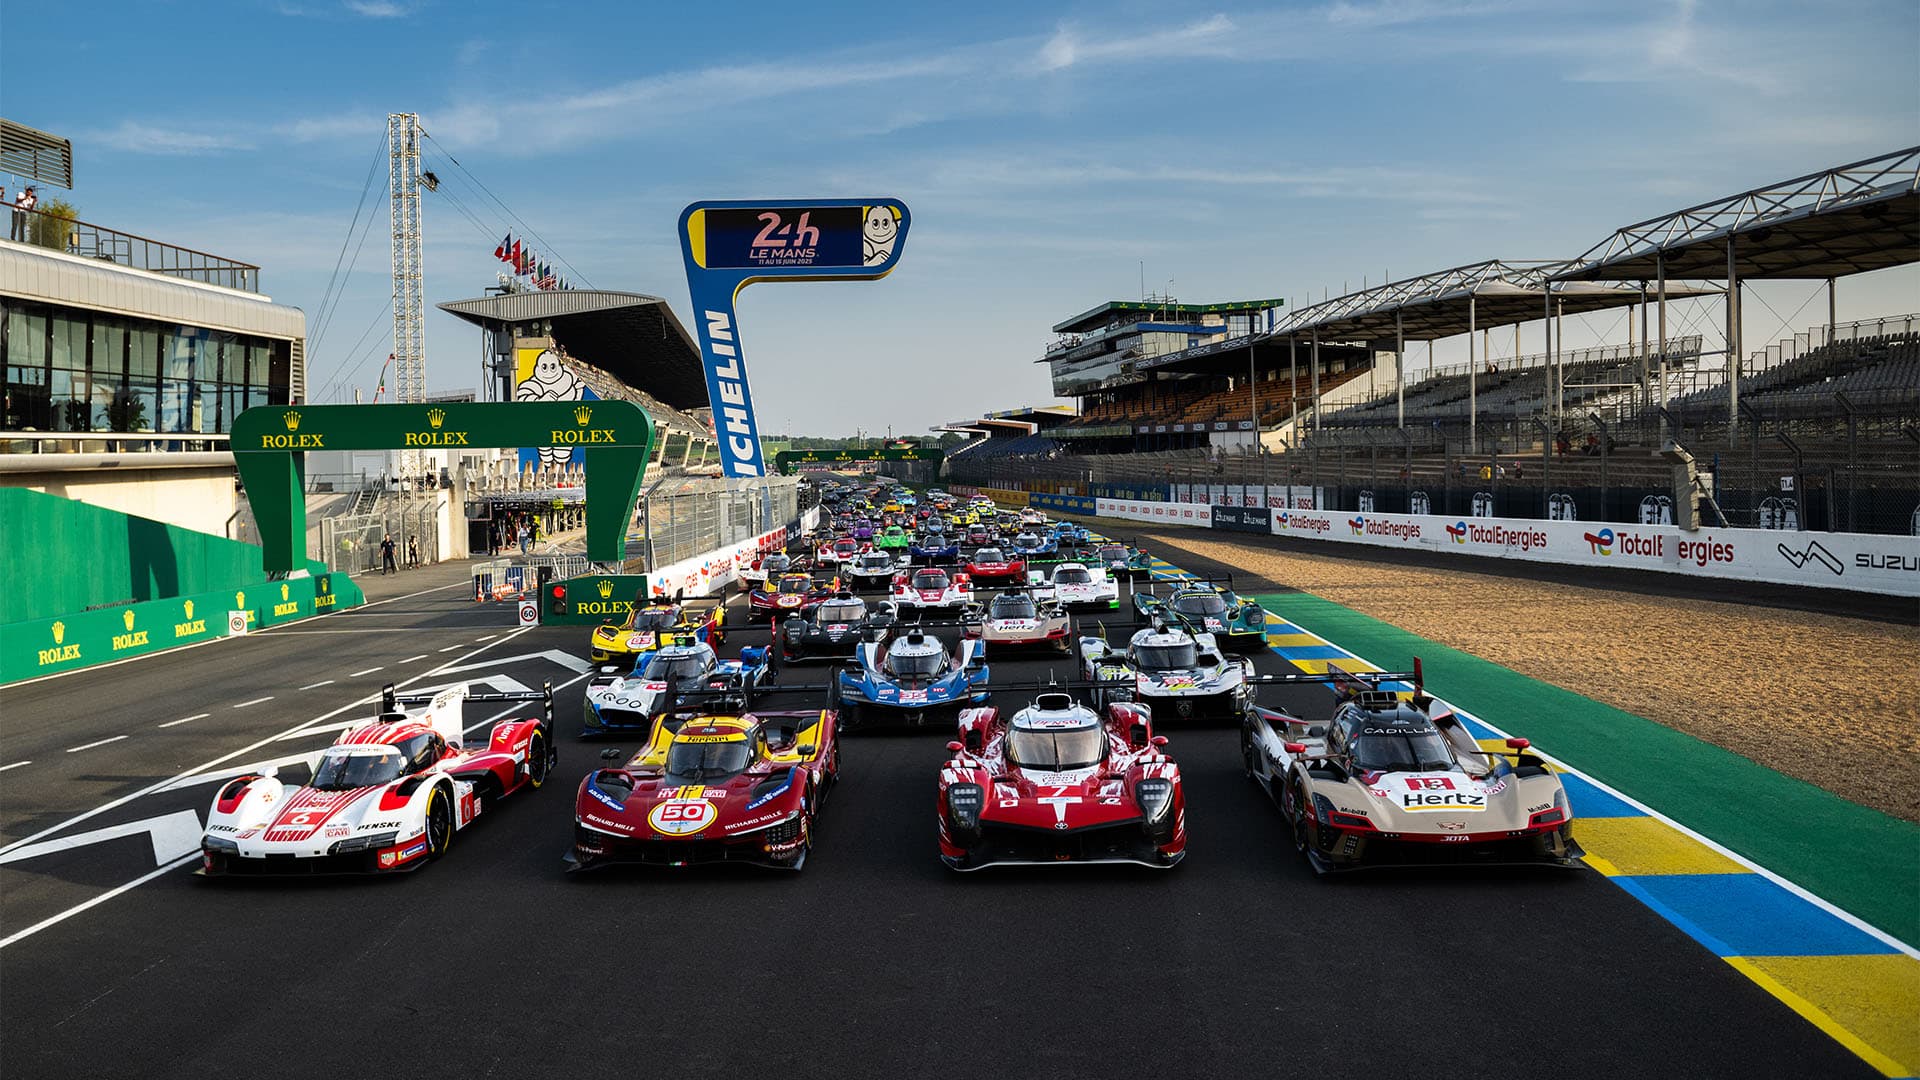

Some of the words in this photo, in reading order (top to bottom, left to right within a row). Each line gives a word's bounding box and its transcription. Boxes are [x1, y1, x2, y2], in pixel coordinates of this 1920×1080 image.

[752, 211, 820, 247] 24h
[750, 249, 768, 258] LE
[771, 248, 816, 258] MANS
[1220, 337, 1248, 349] PORSCHE
[704, 310, 758, 476] ICHELIN
[262, 434, 324, 448] ROLEX
[405, 432, 468, 445] ROLEX
[551, 429, 616, 443] ROLEX
[1269, 496, 1284, 508] BOSCH
[1642, 504, 1672, 525] FIA
[1289, 514, 1330, 534] TotalEnergies
[1365, 520, 1420, 541] TotalEnergies
[1468, 524, 1547, 551] TotalEnergies
[1617, 532, 1734, 566] TotalEergies
[1856, 553, 1920, 571] SUZU
[315, 594, 336, 608] ROLEX
[577, 601, 635, 614] ROLEX
[274, 602, 298, 616] ROLEX
[524, 610, 534, 618] 60
[175, 620, 206, 638] ROLEX
[112, 631, 148, 650] ROLEX
[38, 644, 81, 666] ROLEX
[657, 790, 676, 798] HY
[1051, 786, 1068, 796] 7
[1404, 793, 1484, 806] Hertz
[464, 796, 471, 820] 6
[663, 805, 703, 819] 50
[290, 812, 311, 824] 6
[586, 814, 614, 827] RICHARD
[614, 823, 636, 831] MILLE
[724, 818, 758, 830] RICHARD
[760, 810, 782, 821] MILLE
[210, 824, 240, 833] PENSKE
[358, 821, 402, 830] PENSKE
